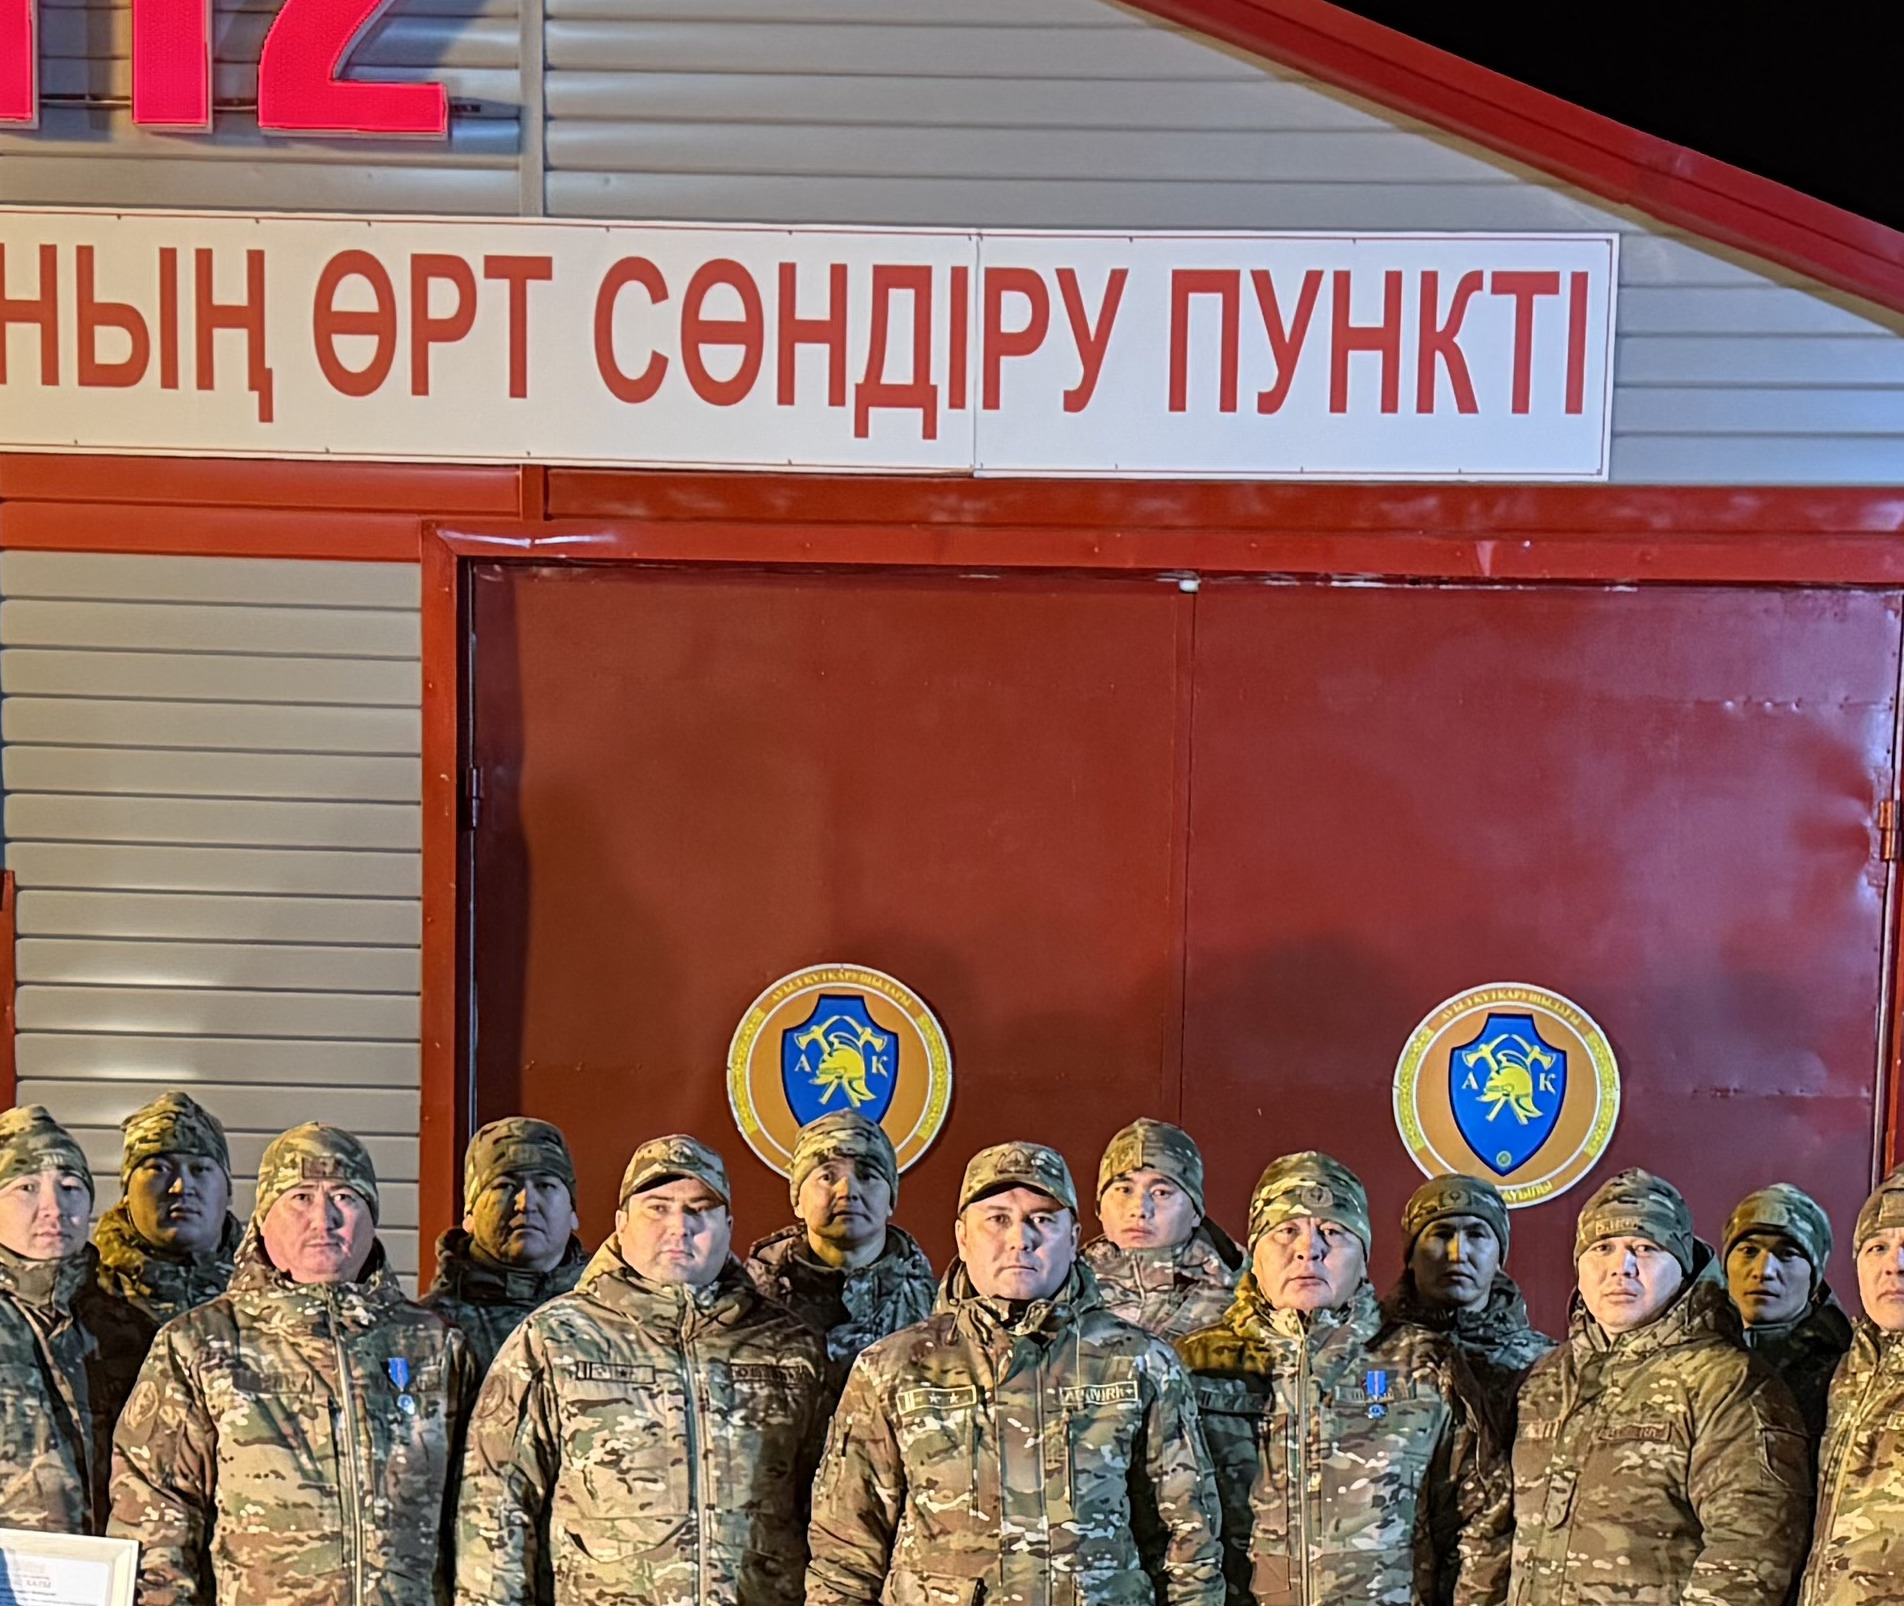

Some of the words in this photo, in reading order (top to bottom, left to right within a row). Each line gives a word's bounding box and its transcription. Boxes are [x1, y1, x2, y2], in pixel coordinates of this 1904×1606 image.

[313, 250, 553, 398] ӨРТ
[595, 257, 1127, 438] СӨНДІРУ
[1169, 270, 1587, 414] ПУНКТІ
